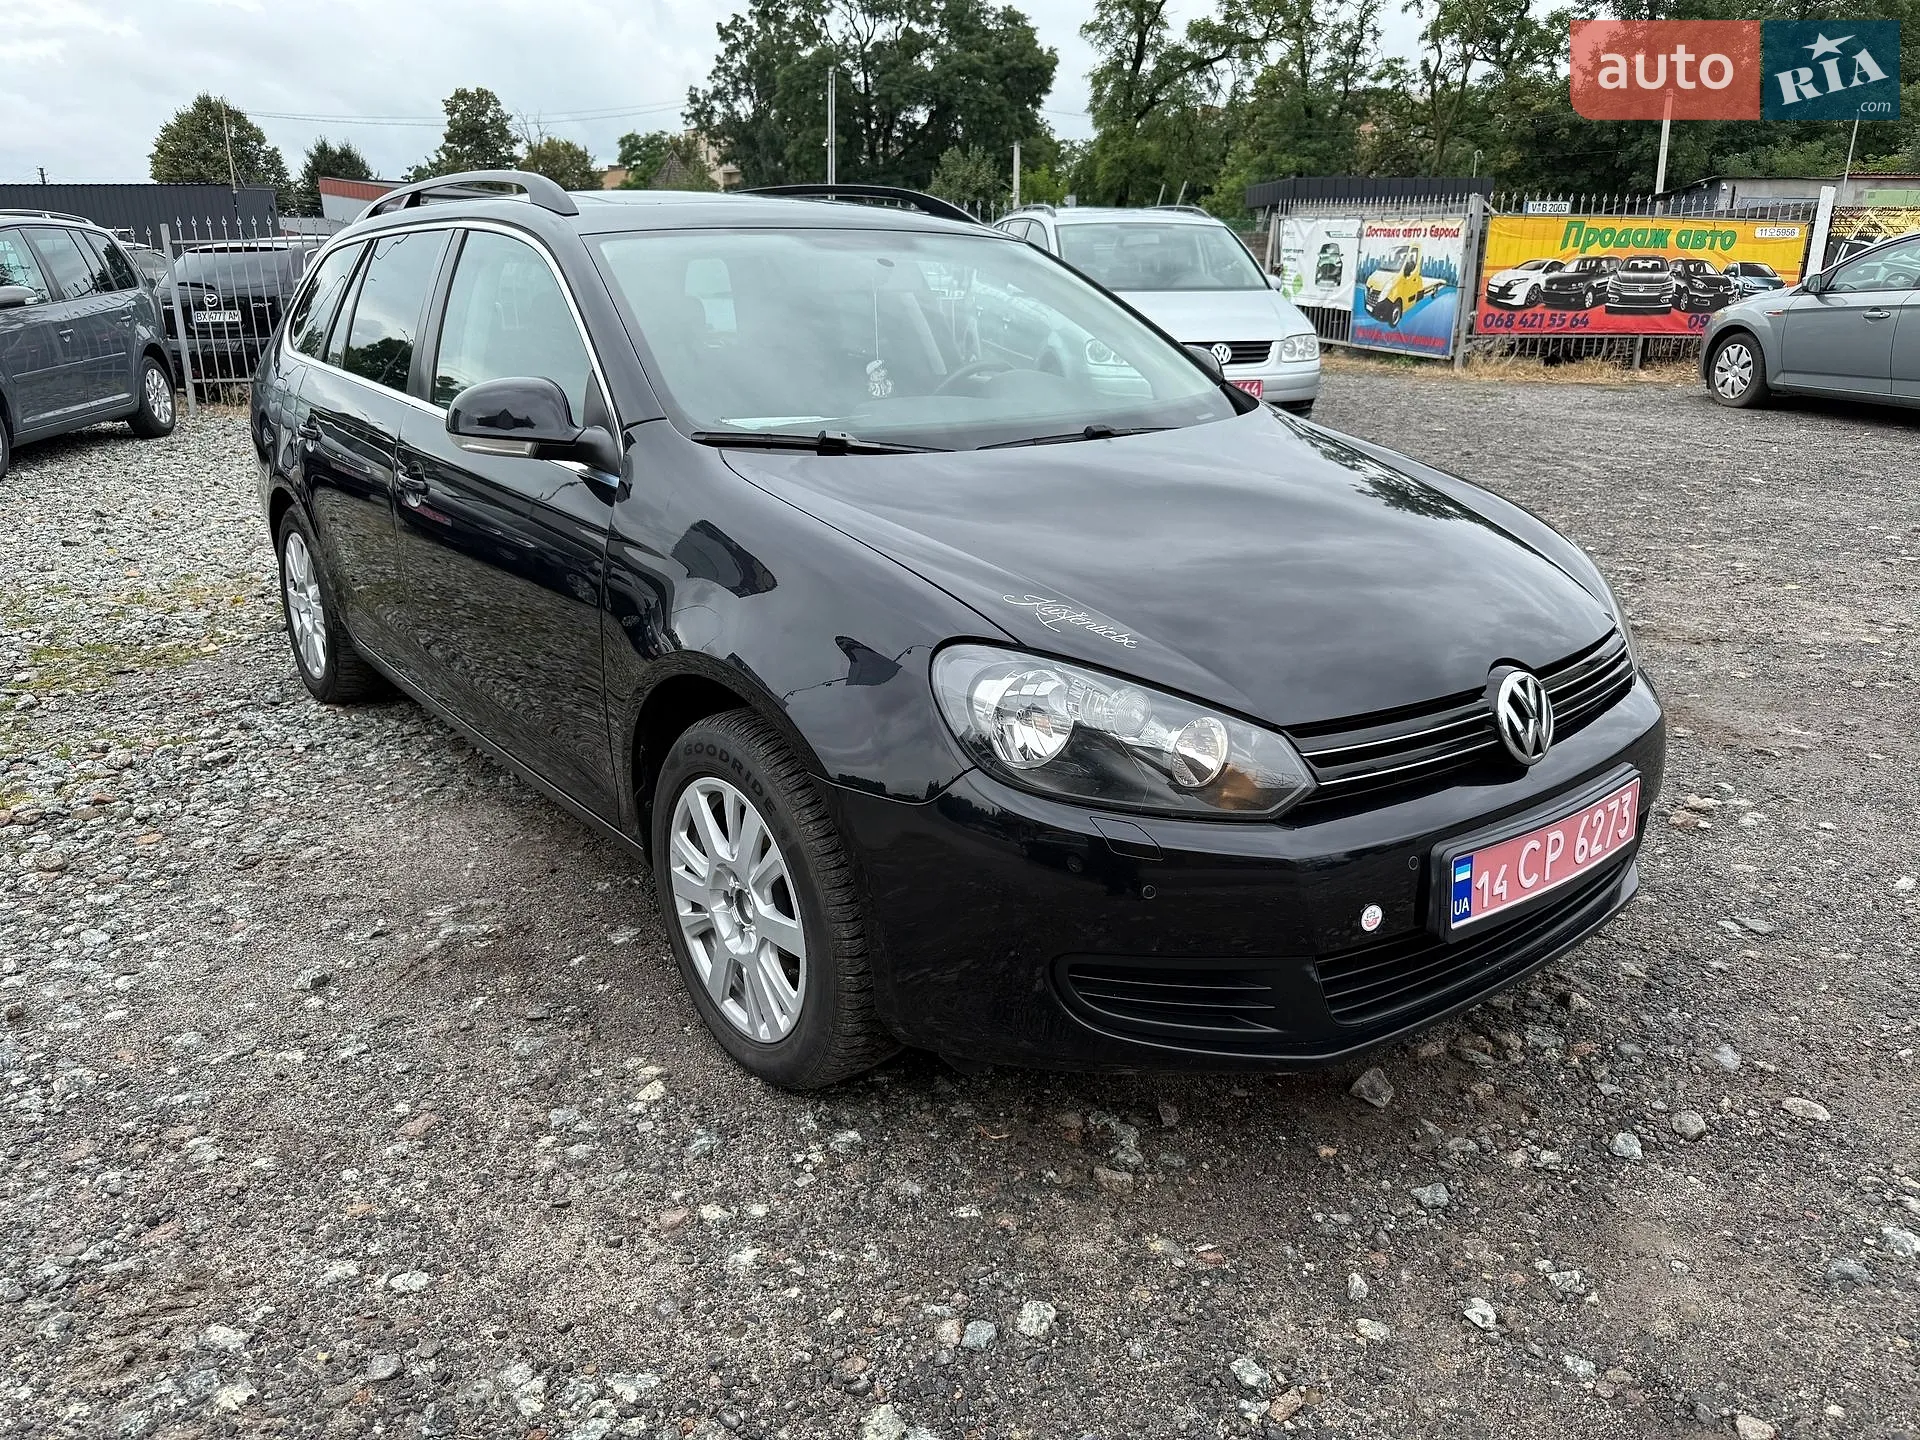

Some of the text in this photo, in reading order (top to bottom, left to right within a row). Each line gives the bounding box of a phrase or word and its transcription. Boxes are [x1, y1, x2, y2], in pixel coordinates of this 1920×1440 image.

[1548, 203, 1568, 212] 2003
[1365, 225, 1401, 238] Доставка
[1402, 227, 1421, 238] авто
[1560, 221, 1738, 254] Продаж авто
[1483, 313, 1590, 329] 068 421 55 64
[684, 742, 777, 817] GOODRIDE
[1475, 790, 1633, 909] 14 CP 6273
[1453, 896, 1470, 916] UA
